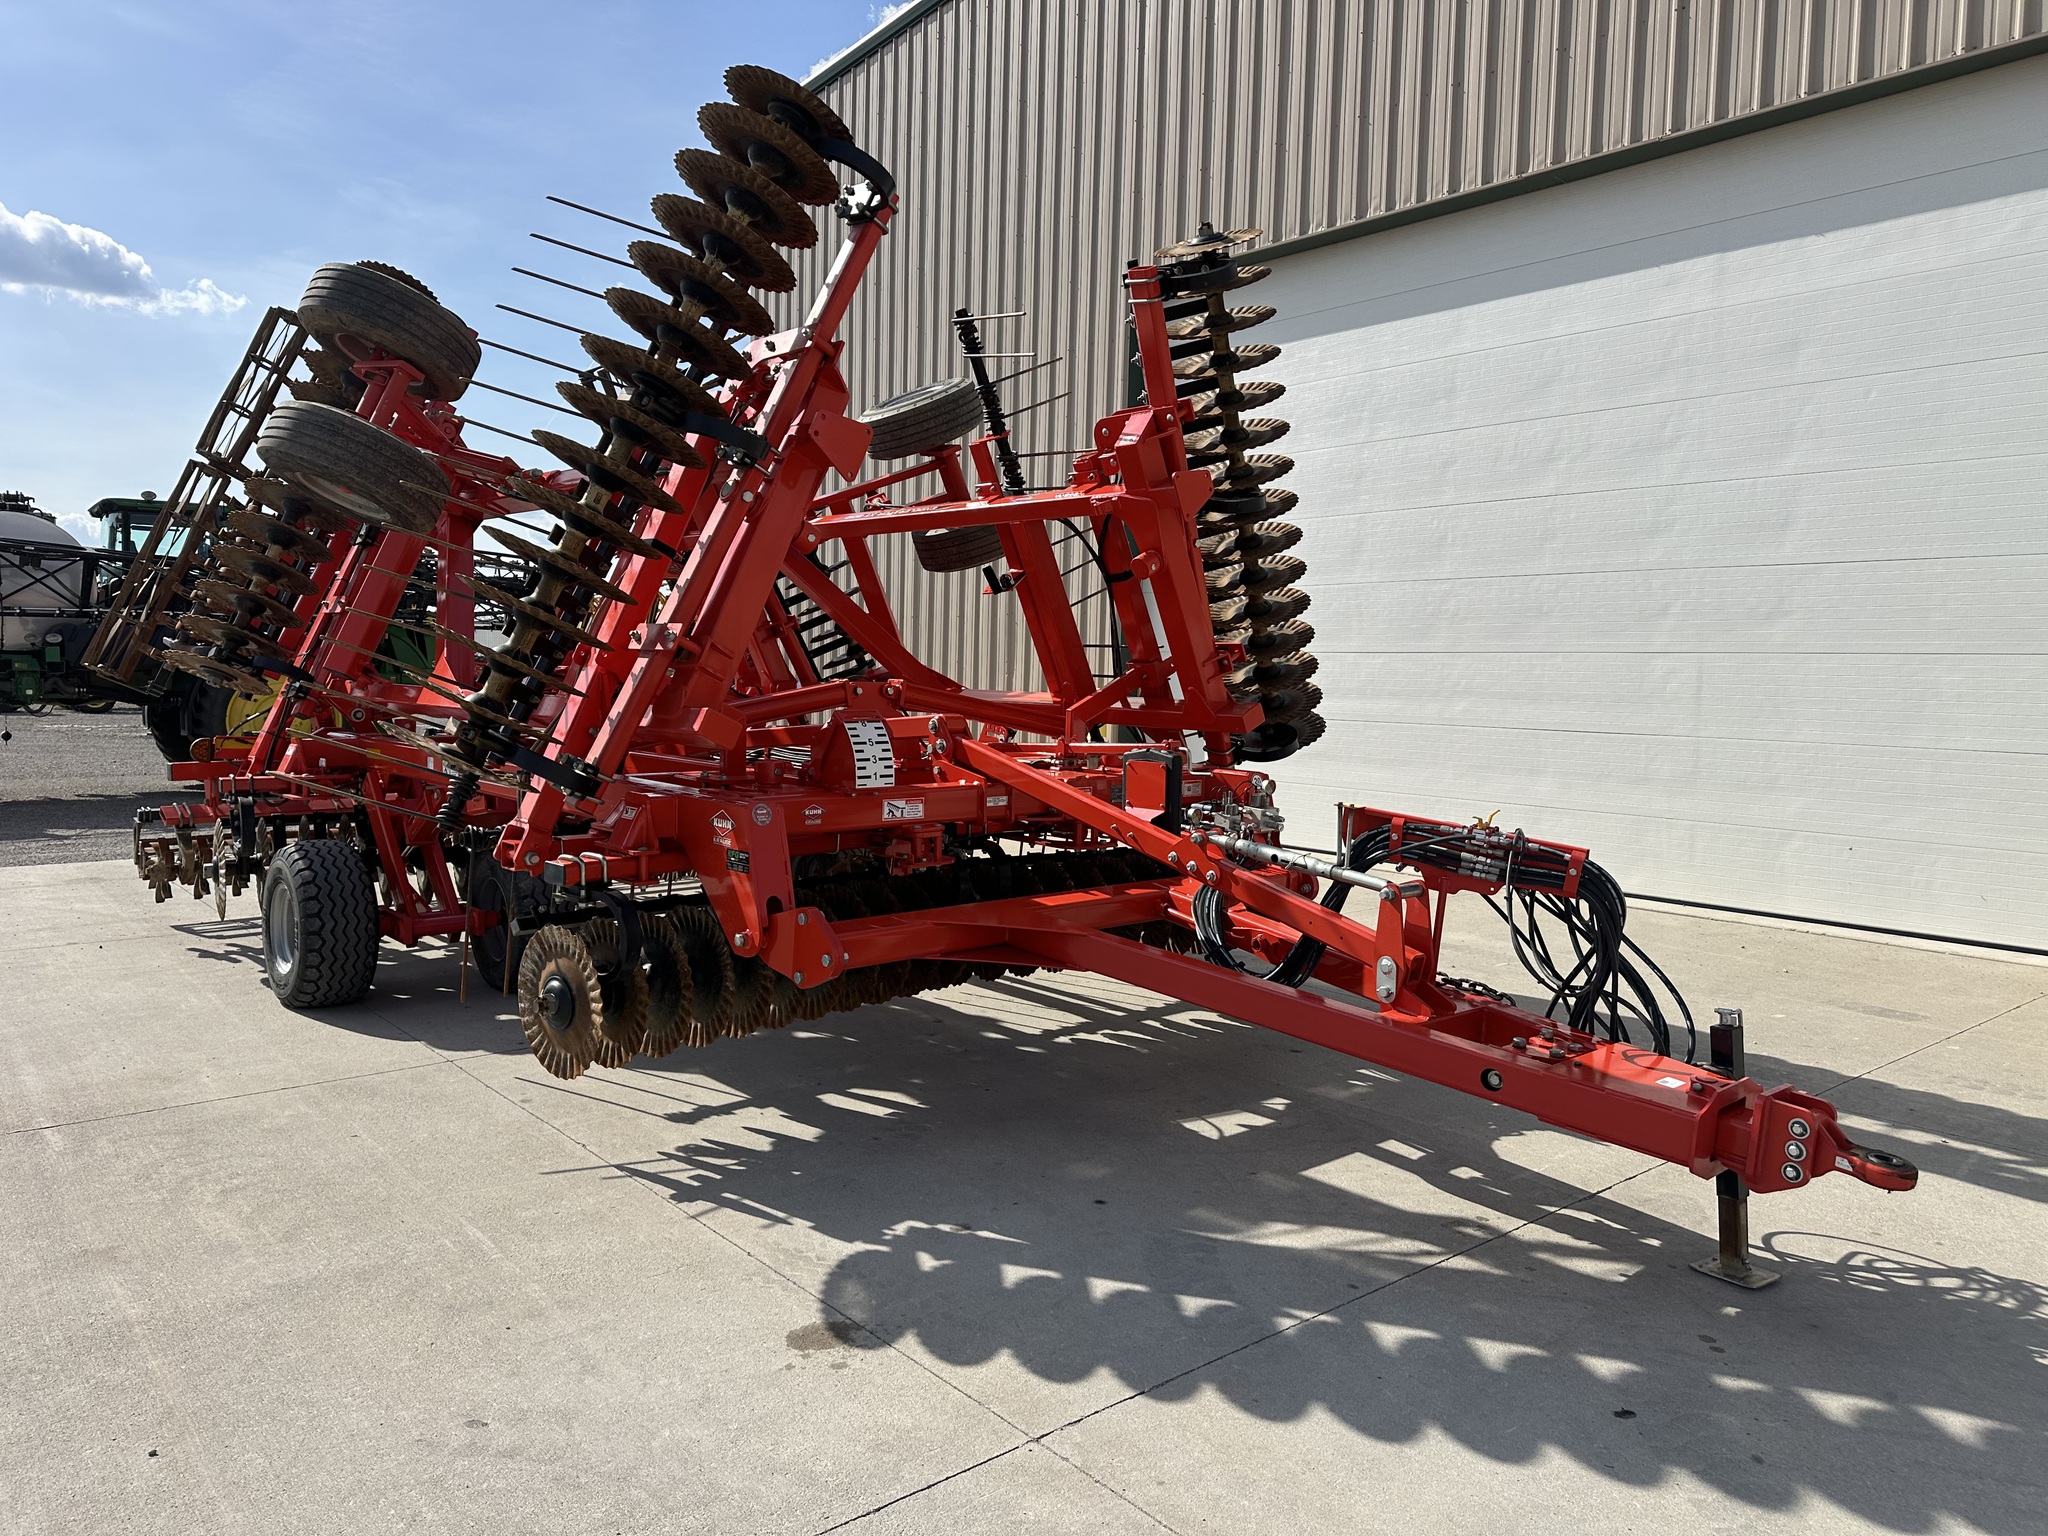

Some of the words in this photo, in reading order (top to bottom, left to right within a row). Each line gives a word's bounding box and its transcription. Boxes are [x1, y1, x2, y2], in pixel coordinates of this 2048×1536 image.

[868, 738, 874, 747] 5
[871, 755, 877, 764] 3
[873, 772, 878, 780] 1
[713, 817, 732, 830] KUHN
